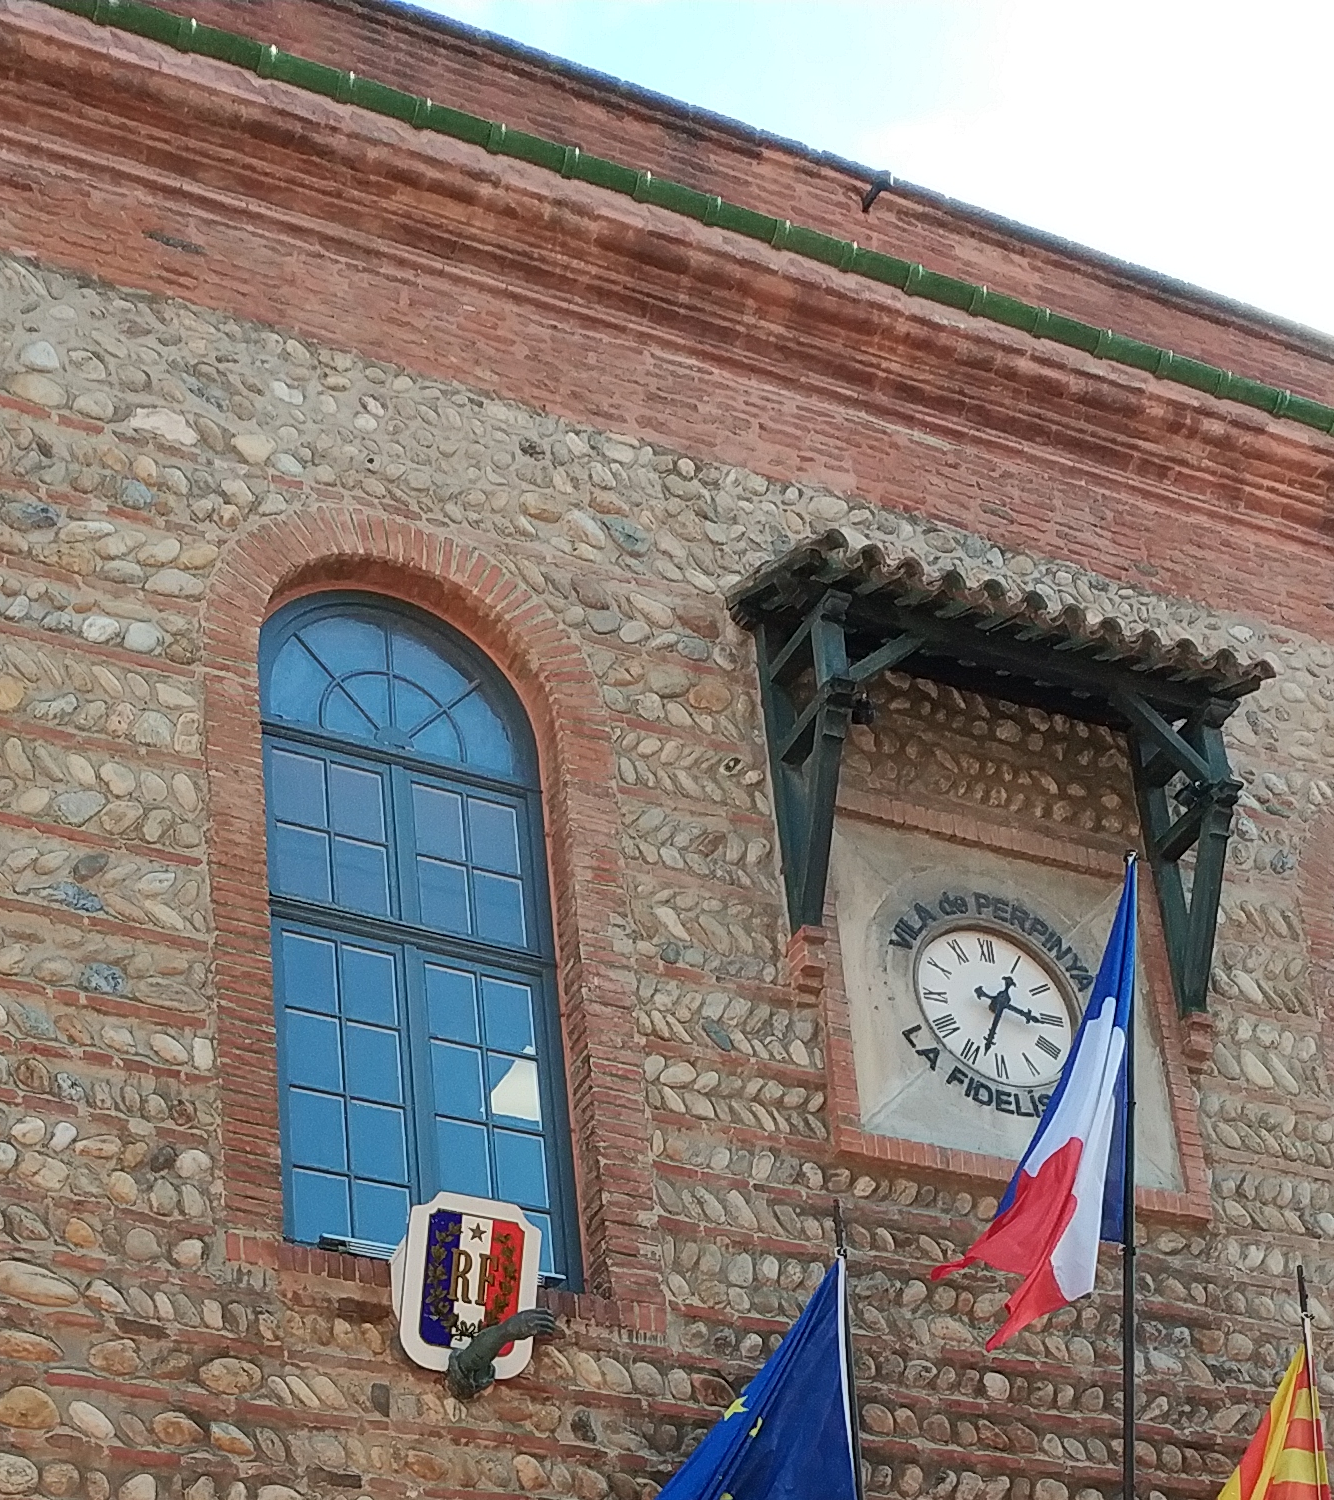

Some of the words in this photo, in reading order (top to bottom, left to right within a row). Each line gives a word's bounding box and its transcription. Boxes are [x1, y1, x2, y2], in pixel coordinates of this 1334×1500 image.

[888, 902, 938, 950] VILA
[901, 1023, 941, 1072] LA
[945, 1065, 1052, 1119] FIDELÍS
[447, 1247, 499, 1306] RF
